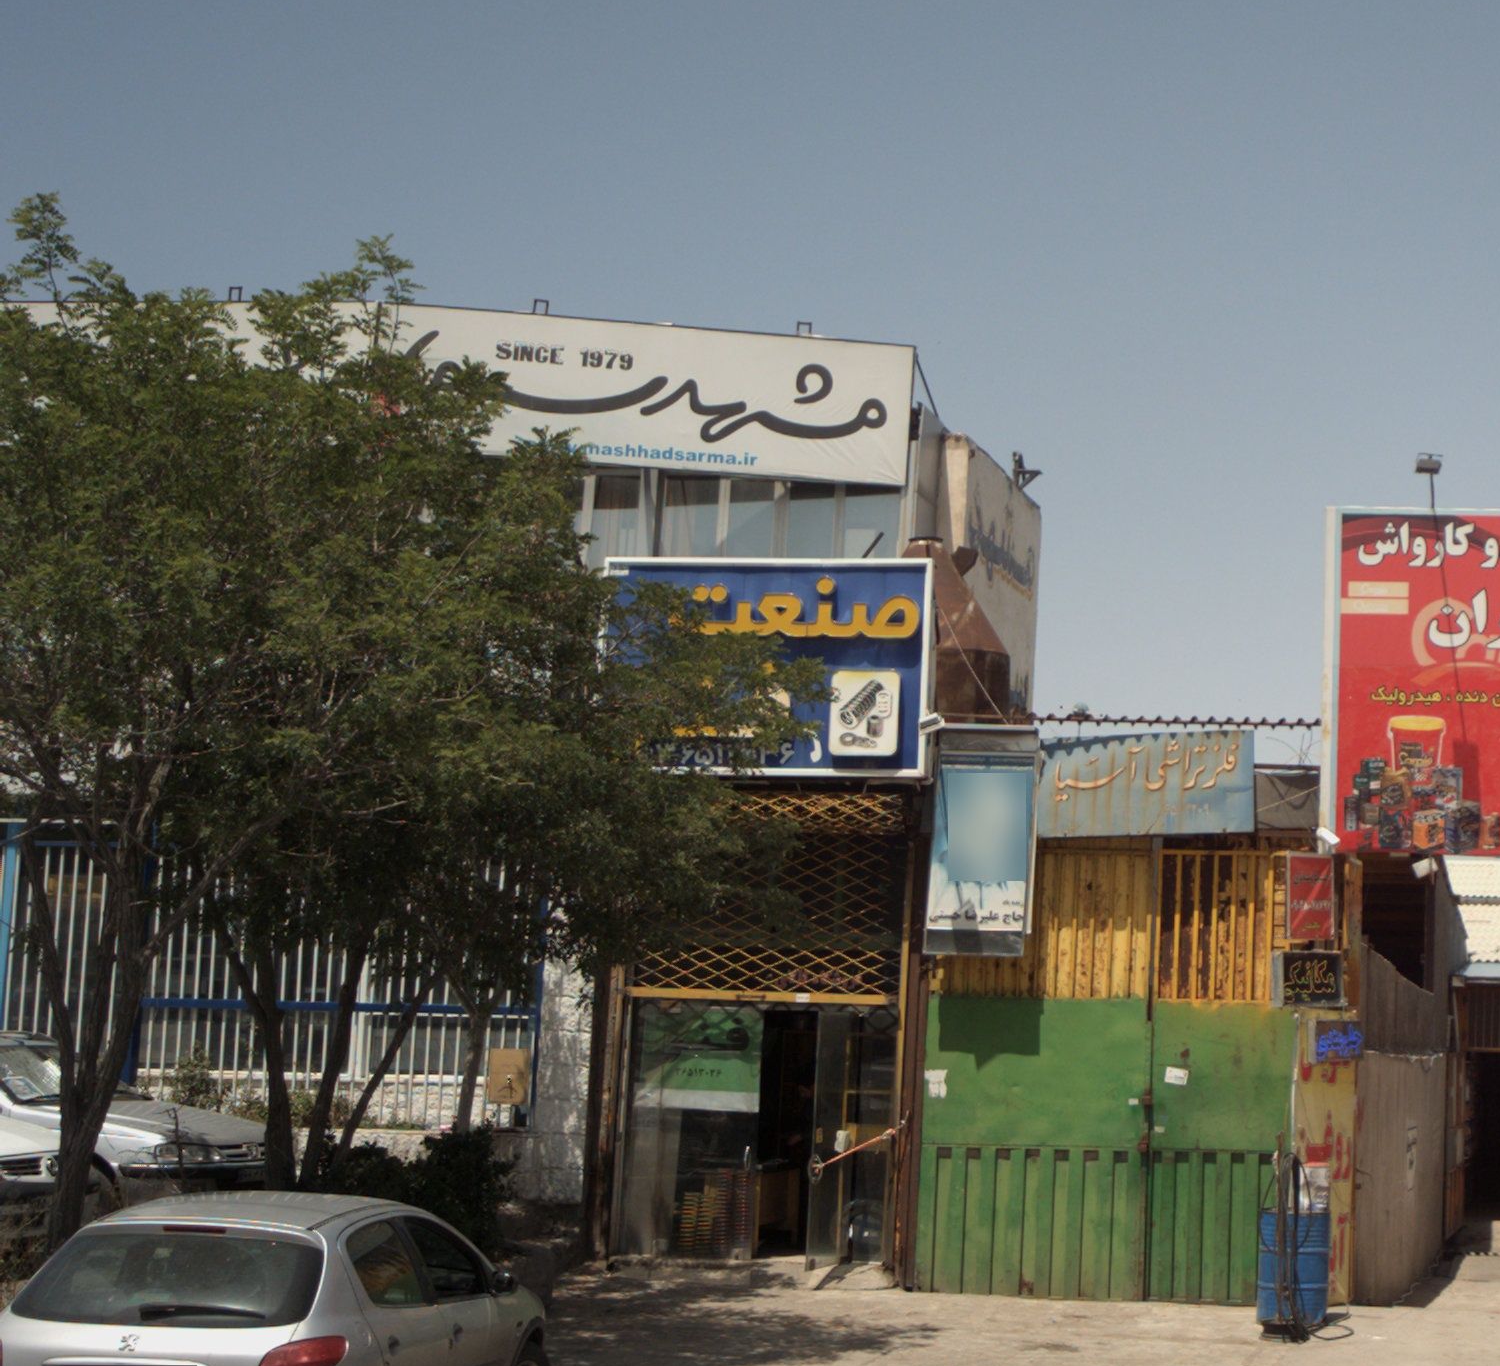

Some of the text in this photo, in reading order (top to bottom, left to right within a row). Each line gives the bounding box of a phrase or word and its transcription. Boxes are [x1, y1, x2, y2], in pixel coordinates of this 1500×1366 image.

[495, 340, 633, 372] SINCE 1979
[1357, 521, 1475, 568] کارواش
[1480, 536, 1500, 569] و
[1370, 686, 1442, 706] هیدرولیک
[1455, 690, 1488, 703] دنده
